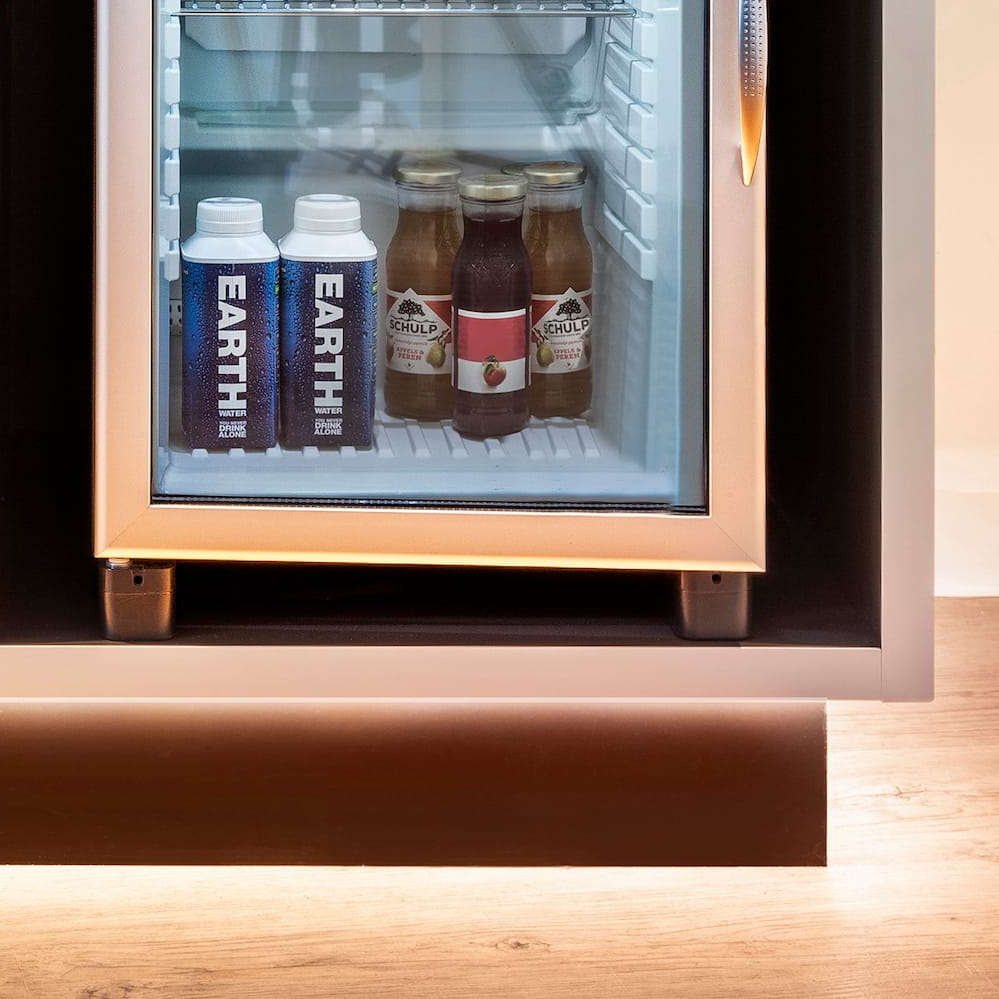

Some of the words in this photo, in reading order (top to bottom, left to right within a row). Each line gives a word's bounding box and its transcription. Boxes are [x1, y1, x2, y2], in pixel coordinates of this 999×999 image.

[390, 319, 438, 334] SCHULP
[543, 319, 590, 334] SCHULP
[218, 275, 247, 410] EARTH
[314, 273, 344, 407] EARTH
[314, 407, 343, 415] WATER
